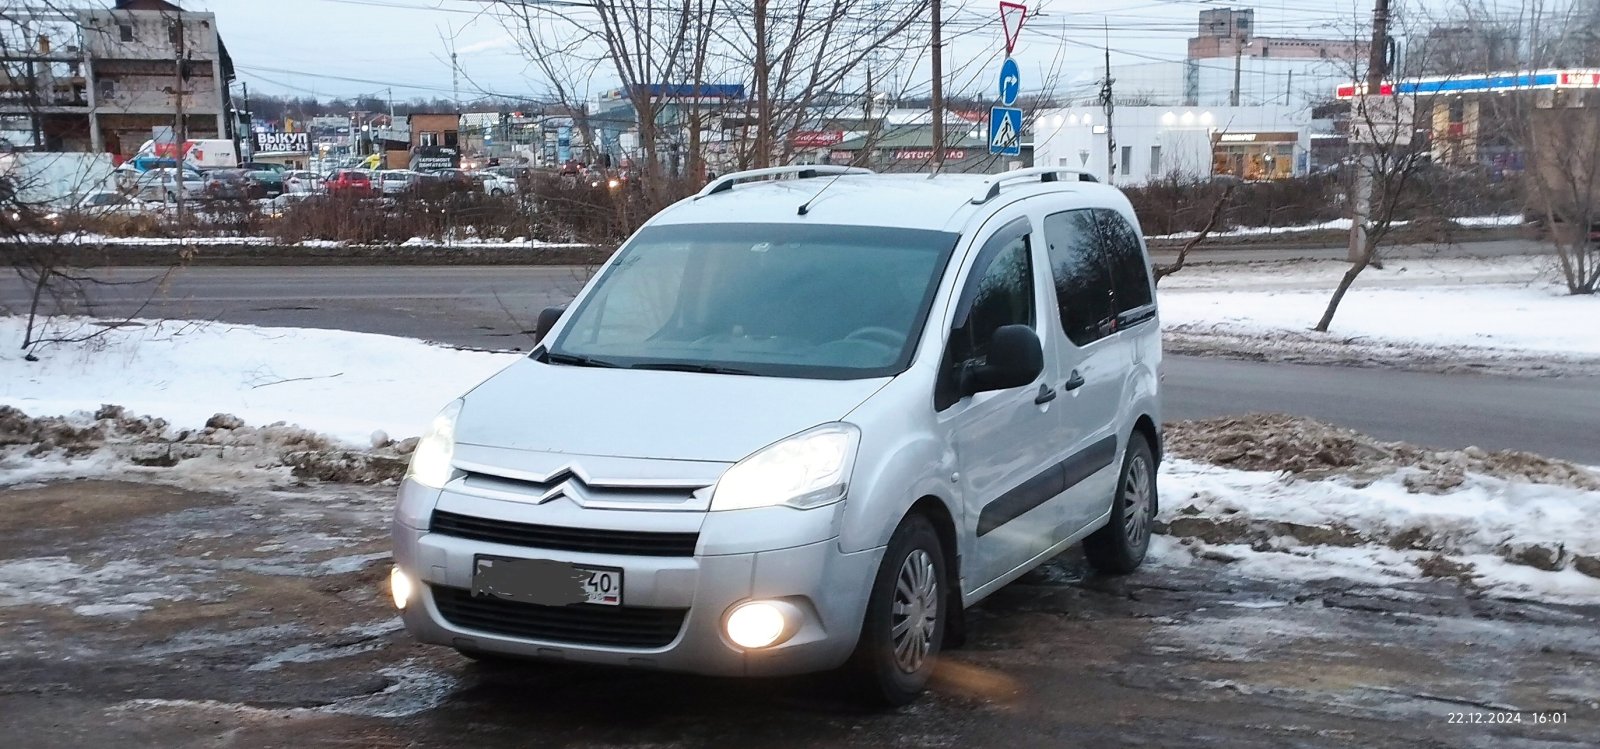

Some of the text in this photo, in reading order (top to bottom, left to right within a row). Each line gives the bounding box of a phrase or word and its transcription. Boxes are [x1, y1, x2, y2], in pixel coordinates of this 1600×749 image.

[257, 132, 307, 144] ВЫКУП
[258, 143, 308, 151] TRADE-IN
[896, 151, 964, 159] АВТОСЛО
[587, 572, 612, 593] 40
